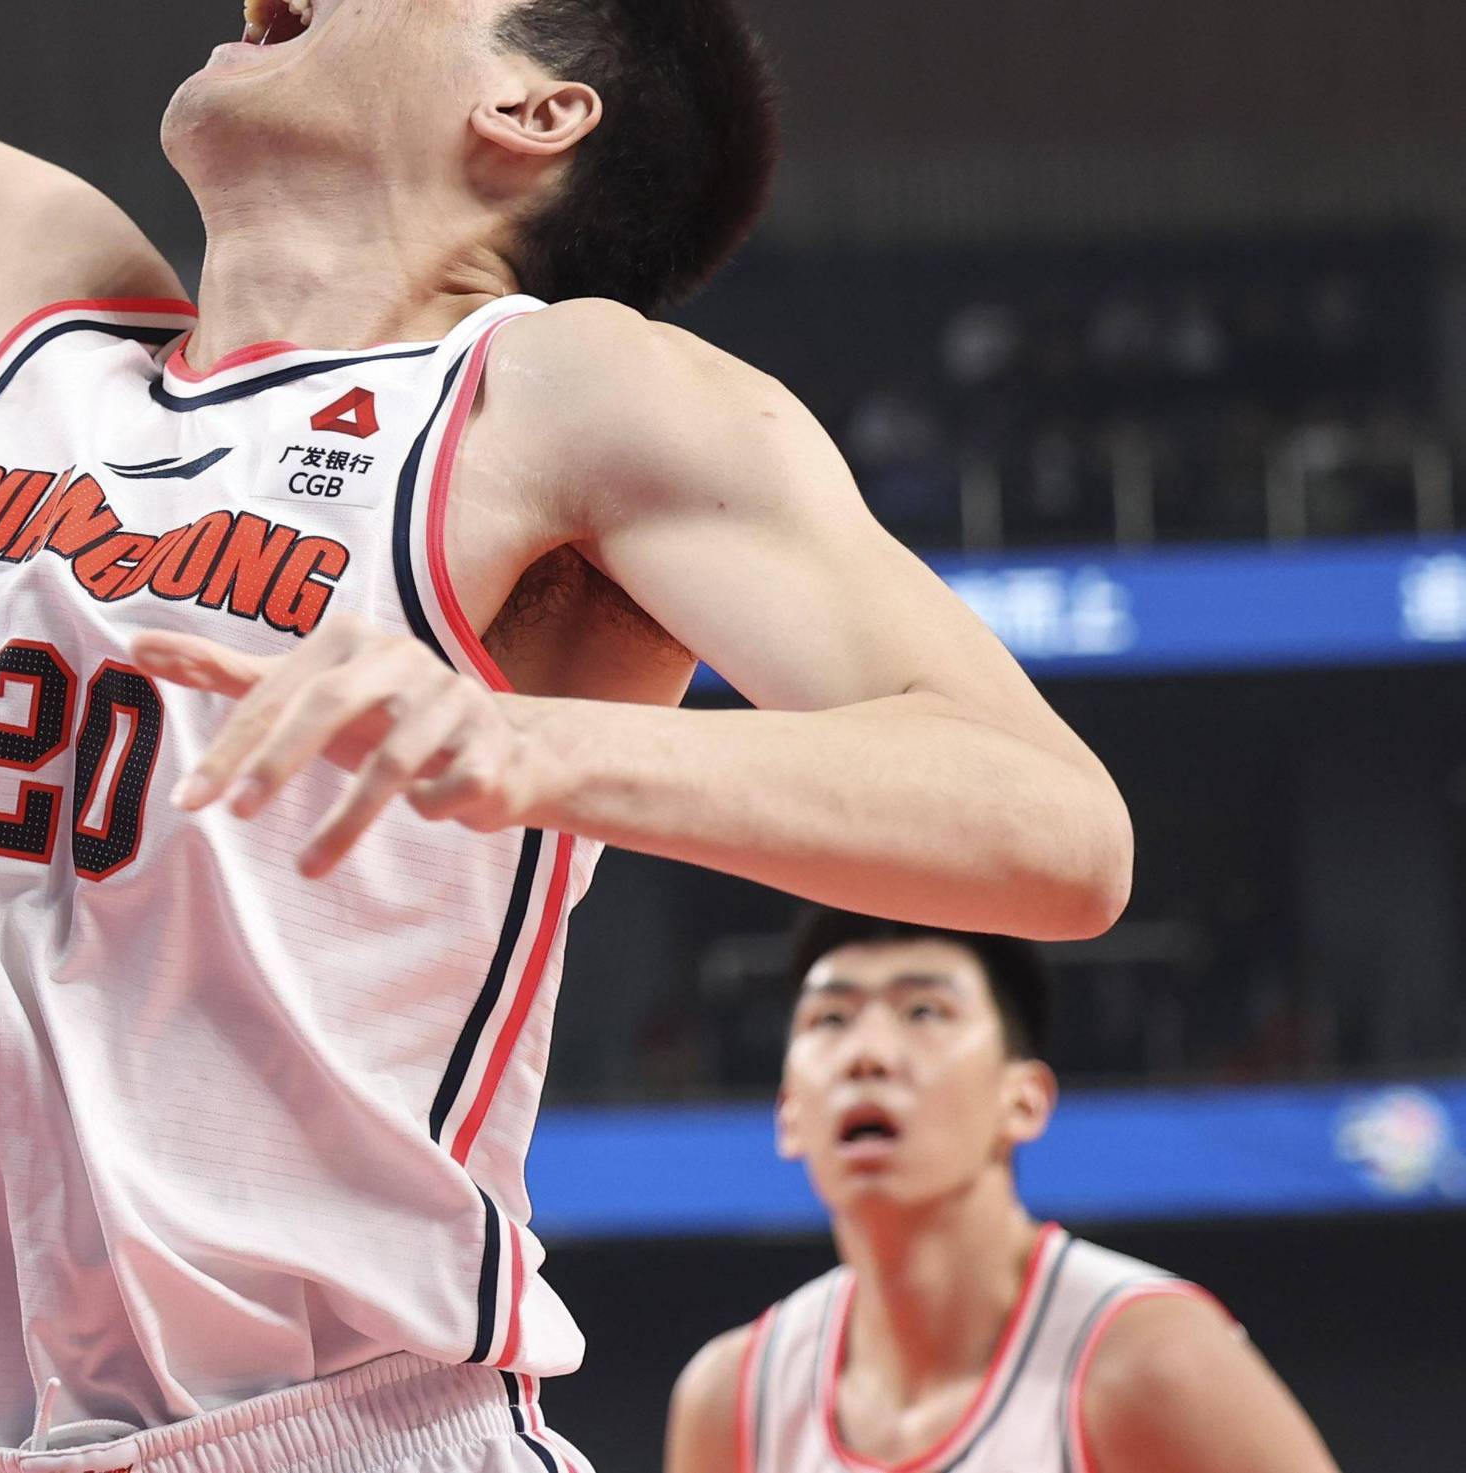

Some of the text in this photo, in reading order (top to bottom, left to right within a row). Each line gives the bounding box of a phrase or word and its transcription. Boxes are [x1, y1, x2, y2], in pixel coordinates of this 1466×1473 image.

[278, 445, 375, 474] 广发银行
[288, 471, 344, 498] CGB
